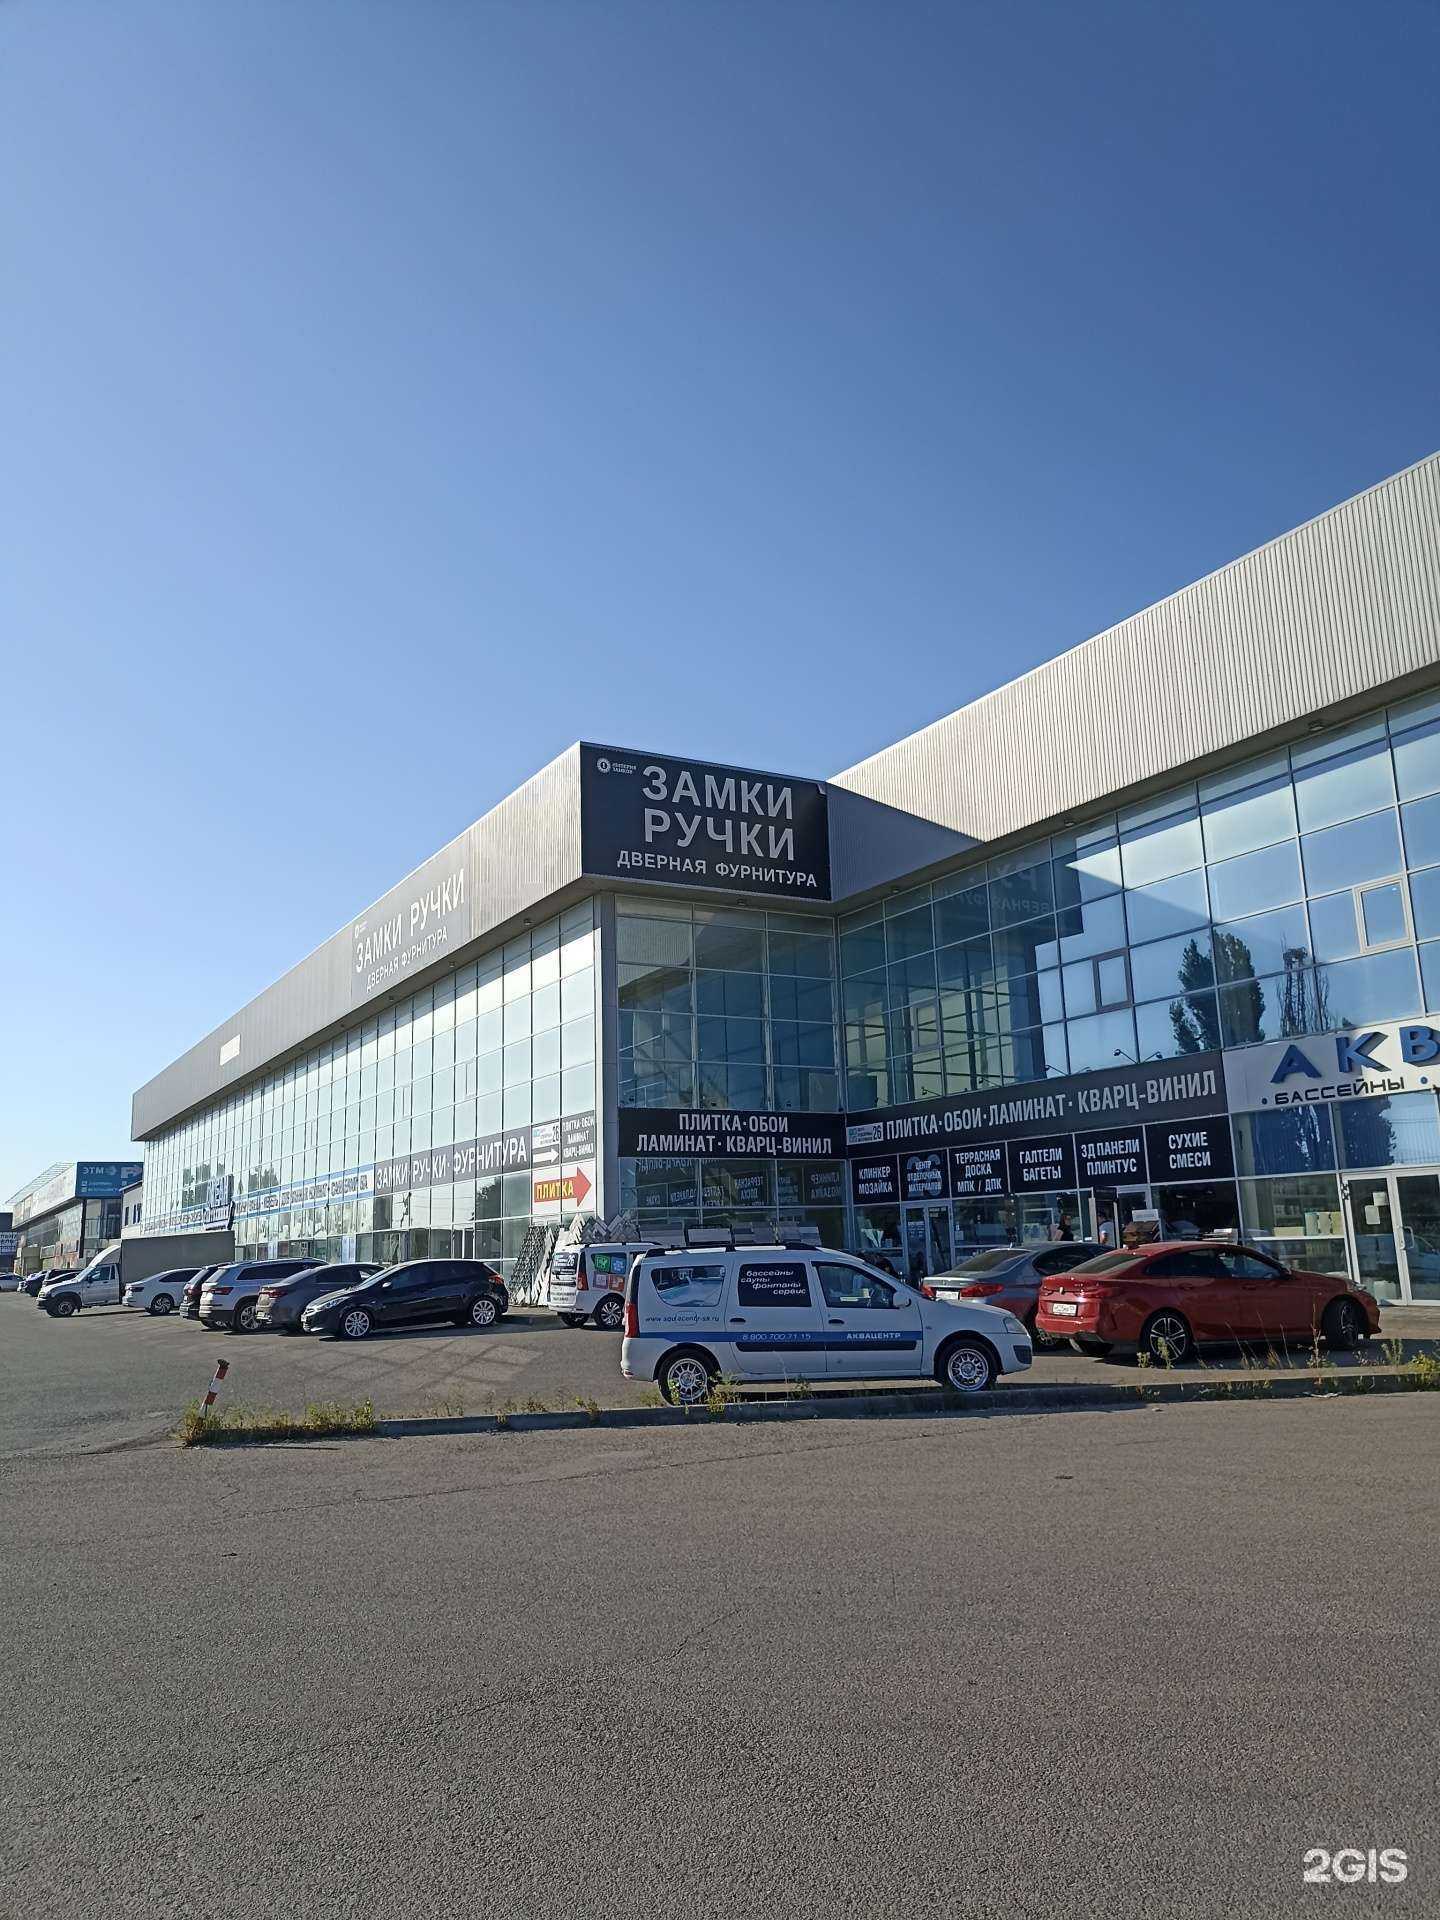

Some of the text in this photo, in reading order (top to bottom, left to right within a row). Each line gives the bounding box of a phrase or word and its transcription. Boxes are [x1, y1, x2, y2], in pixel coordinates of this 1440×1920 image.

[642, 765, 793, 820] ЗАМКИ
[643, 807, 795, 861] РУЧКИ
[616, 850, 818, 888] ДВЕРНАЯ ФУРНИТУРА
[355, 867, 465, 973] ЗАМКИ РУЧКИ
[366, 925, 448, 994] ДВЕРНАЯ ФУРНИТУРА
[1077, 1070, 1217, 1114] КВАРЦ-ВИНИЛ
[1274, 1076, 1405, 1106] БАССЕЙНЫ
[636, 1134, 832, 1156] ЛАМИНАТ КВАРЦ-ВИНИЛ
[1097, 1138, 1140, 1156] ПАНЕЛИ
[1168, 1131, 1209, 1149] СУХИЕ
[376, 1162, 408, 1190] ЗАМКИ
[453, 1135, 528, 1175] ФУРНИТУРА
[955, 1148, 1001, 1164] ТЕРРАСНАЯ
[1019, 1147, 1063, 1165] ГАЛТЕЛИ
[1169, 1151, 1212, 1169] СМЕСИ
[82, 1166, 105, 1175] ЭТМ
[858, 1166, 891, 1180] КЛИНКЕР
[964, 1163, 993, 1179] ДОСКА
[1022, 1165, 1062, 1182] БАГЕТЫ
[1086, 1158, 1137, 1176] ПЛИНТУС
[536, 1180, 574, 1200] ПЛИТКА
[858, 1180, 893, 1195] МОЗАЙКА
[957, 1180, 976, 1193] МПК
[984, 1178, 1002, 1193] ДПК
[741, 1277, 770, 1285] сауны
[752, 1282, 801, 1290] фонтаны
[773, 1288, 806, 1296] сервис
[846, 1332, 901, 1340] АКВАЦЕНТР
